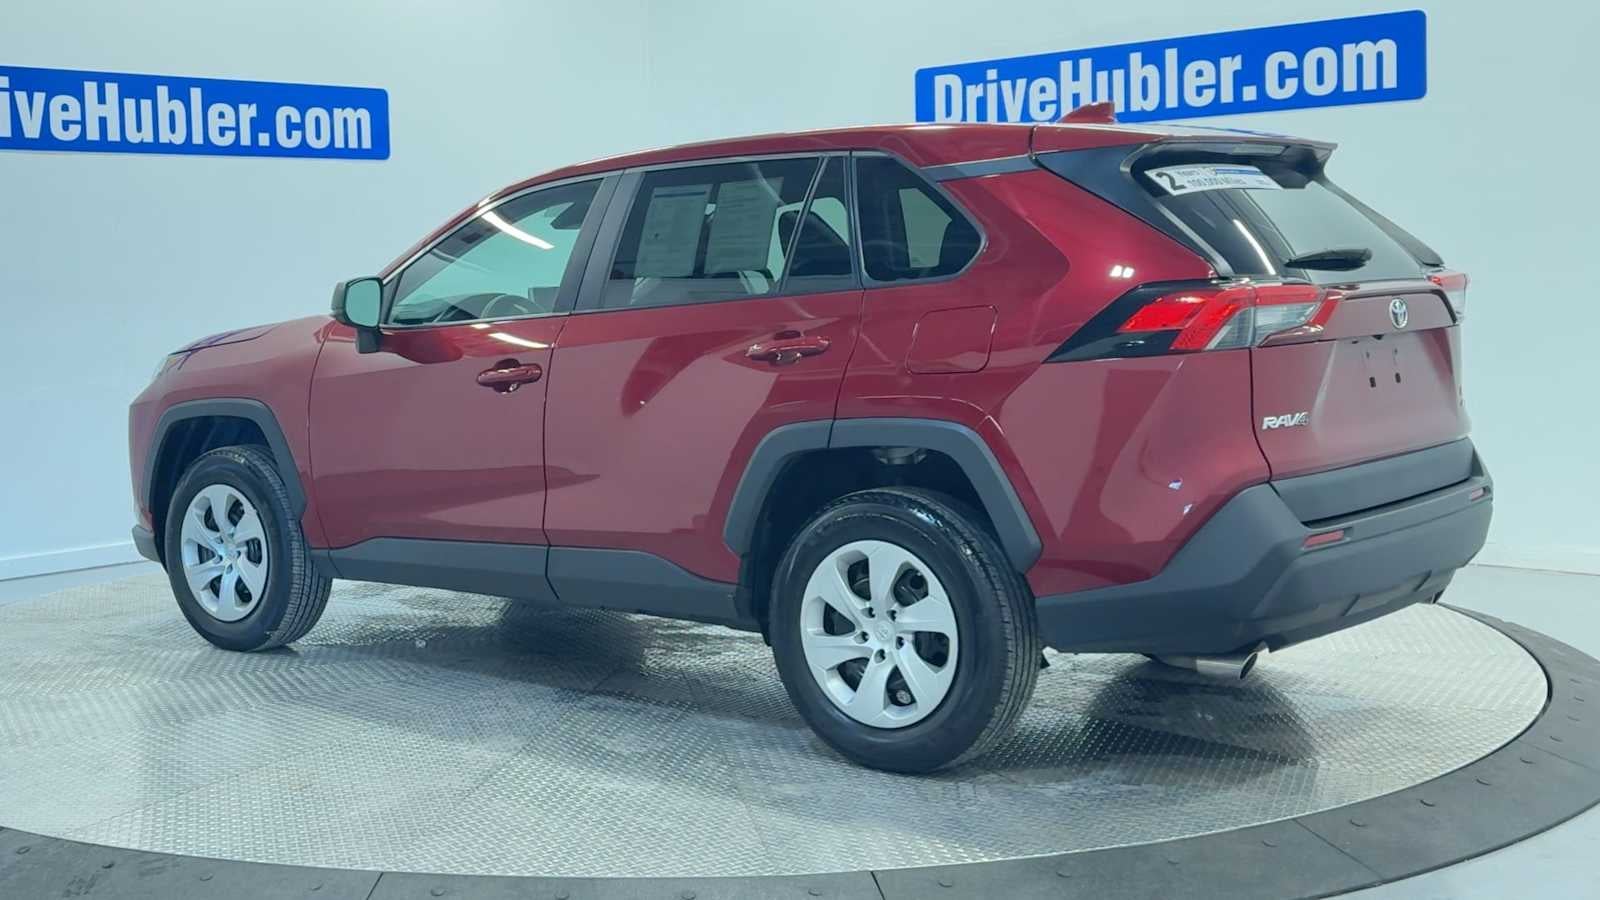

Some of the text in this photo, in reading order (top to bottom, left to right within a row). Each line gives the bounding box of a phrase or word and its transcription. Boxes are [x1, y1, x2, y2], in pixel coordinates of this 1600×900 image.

[934, 37, 1398, 123] DriveHubler.com
[1155, 171, 1187, 191] 2
[1262, 411, 1310, 430] RAV4
